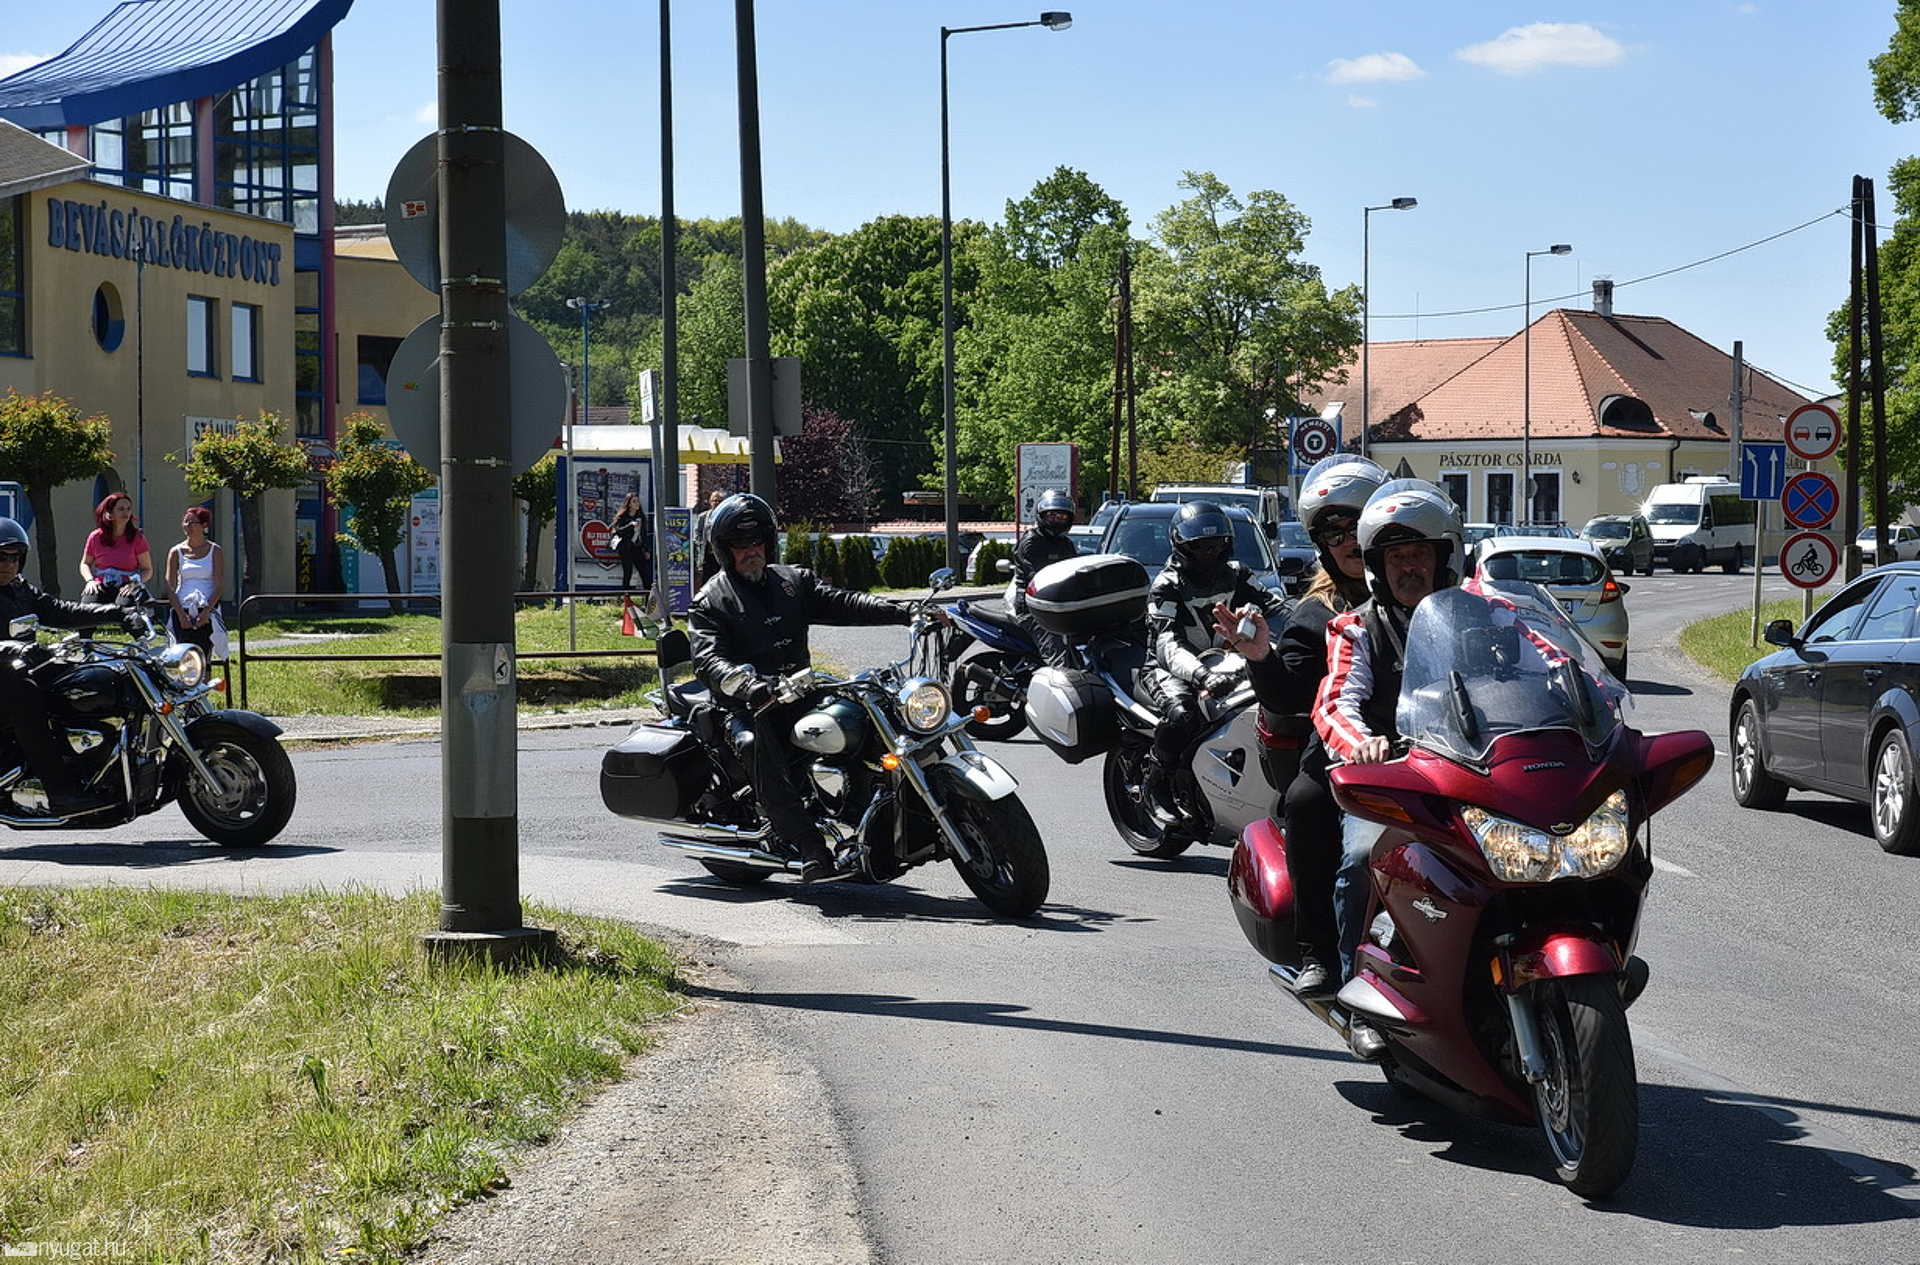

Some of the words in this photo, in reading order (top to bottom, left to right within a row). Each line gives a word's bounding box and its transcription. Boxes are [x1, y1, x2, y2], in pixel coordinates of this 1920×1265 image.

[48, 198, 281, 286] BEVÁSÁRLÓKÖZPONT
[1310, 438, 1320, 448] T
[1439, 451, 1502, 467] PÁSZTOR
[1523, 761, 1566, 772] HONDA
